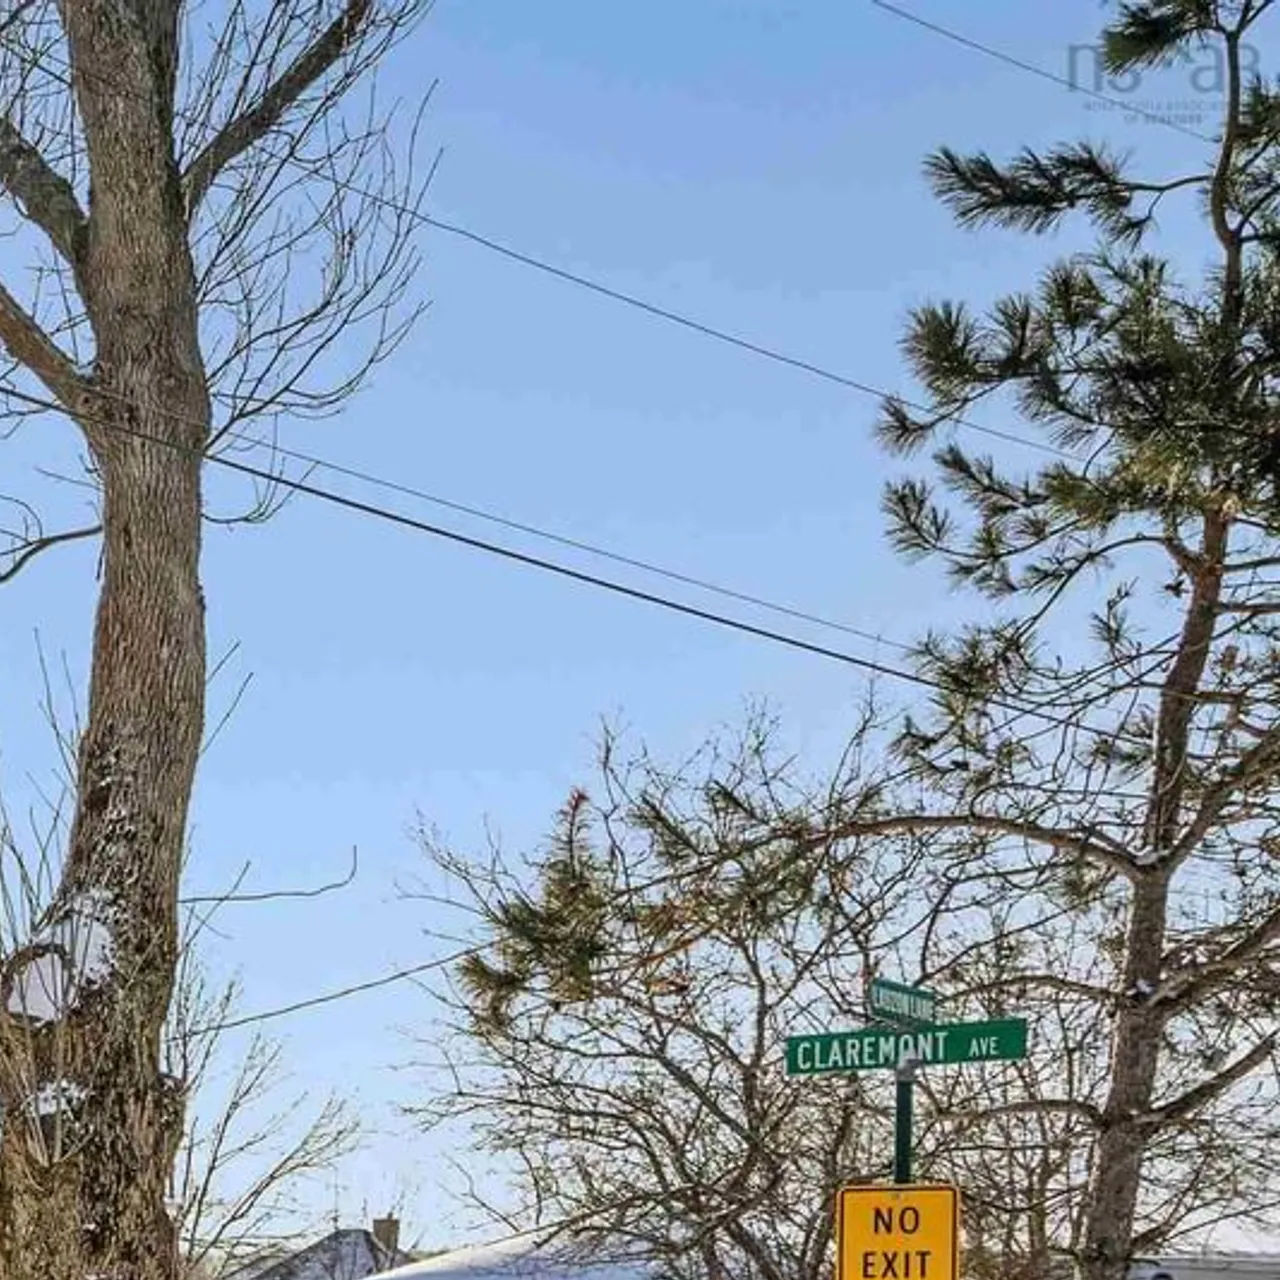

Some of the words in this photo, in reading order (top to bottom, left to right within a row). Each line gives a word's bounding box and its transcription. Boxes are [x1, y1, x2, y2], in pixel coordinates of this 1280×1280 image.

[797, 1031, 949, 1070] CLAREMONT
[968, 1036, 998, 1058] AVE
[873, 1206, 920, 1235] NO
[862, 1250, 932, 1279] EXIT
